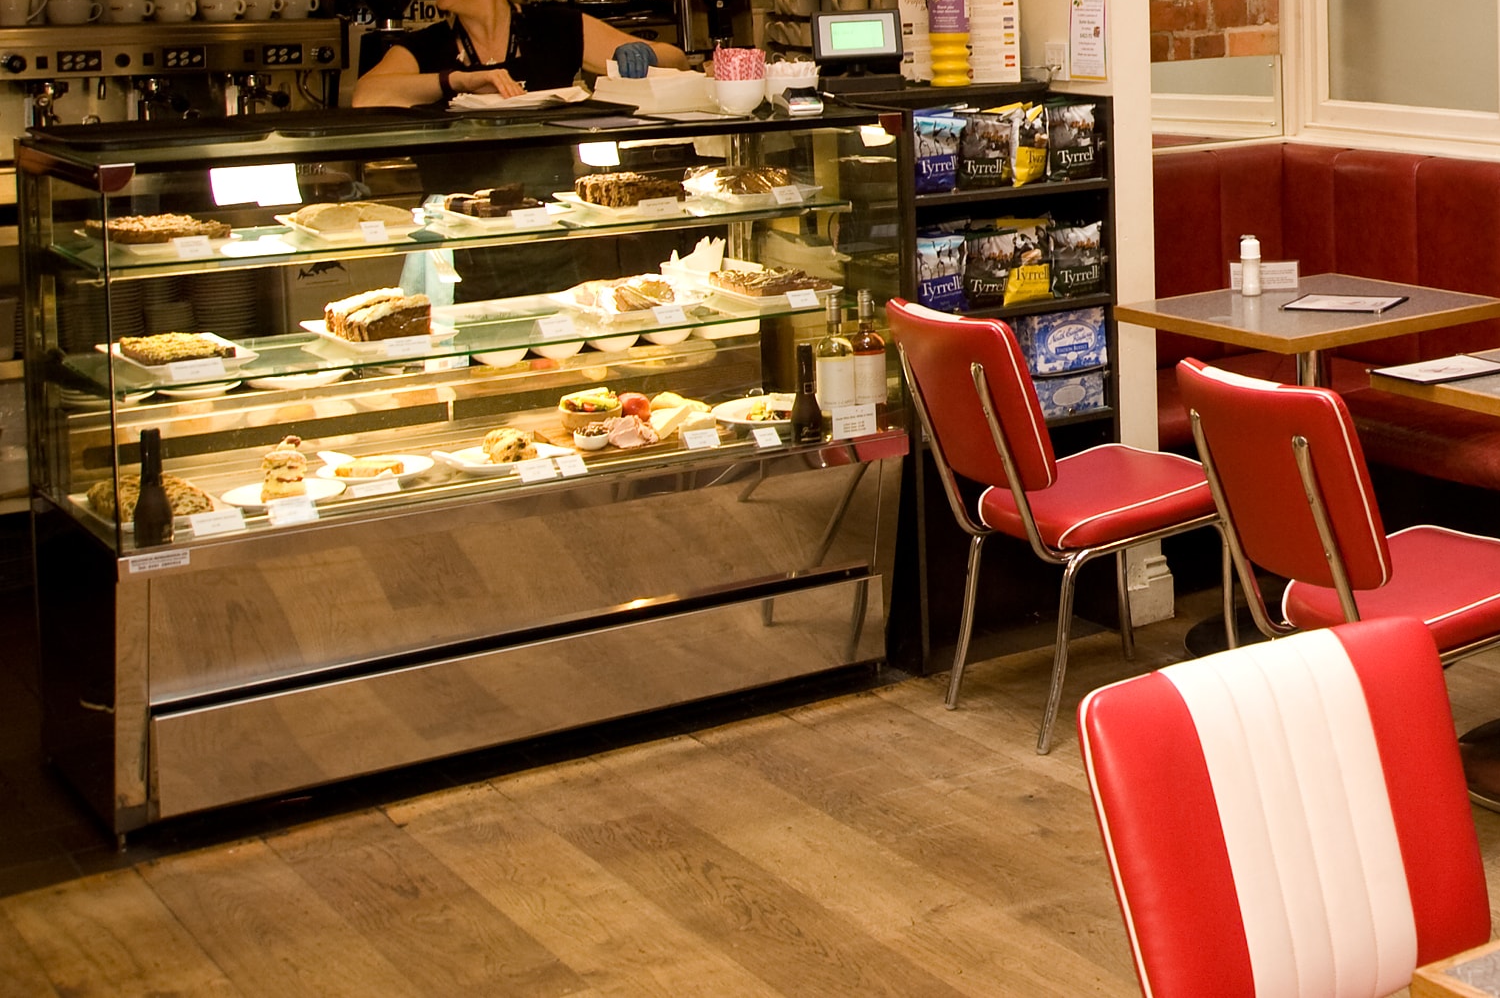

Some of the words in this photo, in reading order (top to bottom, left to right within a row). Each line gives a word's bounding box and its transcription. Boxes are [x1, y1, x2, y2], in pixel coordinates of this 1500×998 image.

[1057, 146, 1095, 169] Tyrrel
[1015, 264, 1050, 286] Tyrrell
[970, 278, 1007, 299] Tyrrel
